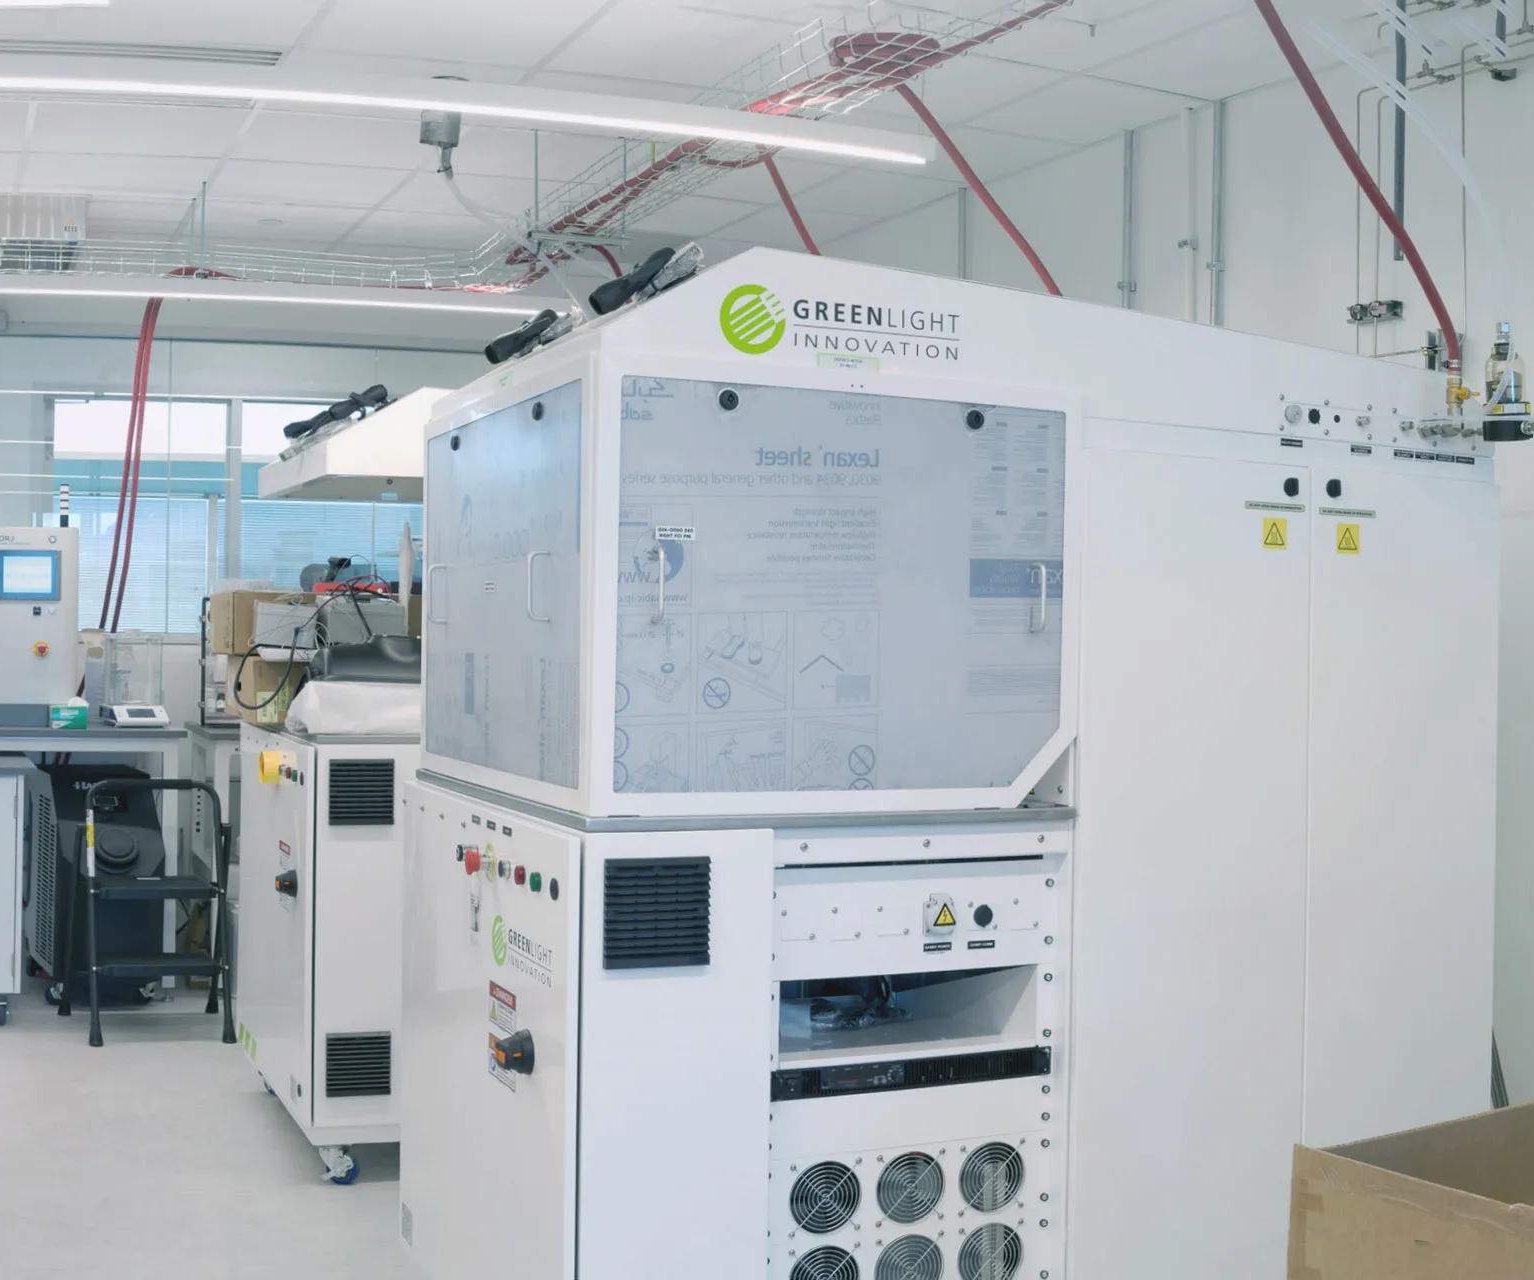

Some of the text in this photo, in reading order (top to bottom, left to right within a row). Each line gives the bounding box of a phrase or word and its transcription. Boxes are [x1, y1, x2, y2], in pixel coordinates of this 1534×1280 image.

[793, 299, 960, 333] GREENLIGHT
[793, 333, 958, 360] INNOVATION
[508, 928, 552, 966] GREENLIGHT
[508, 953, 552, 988] INNOVATION
